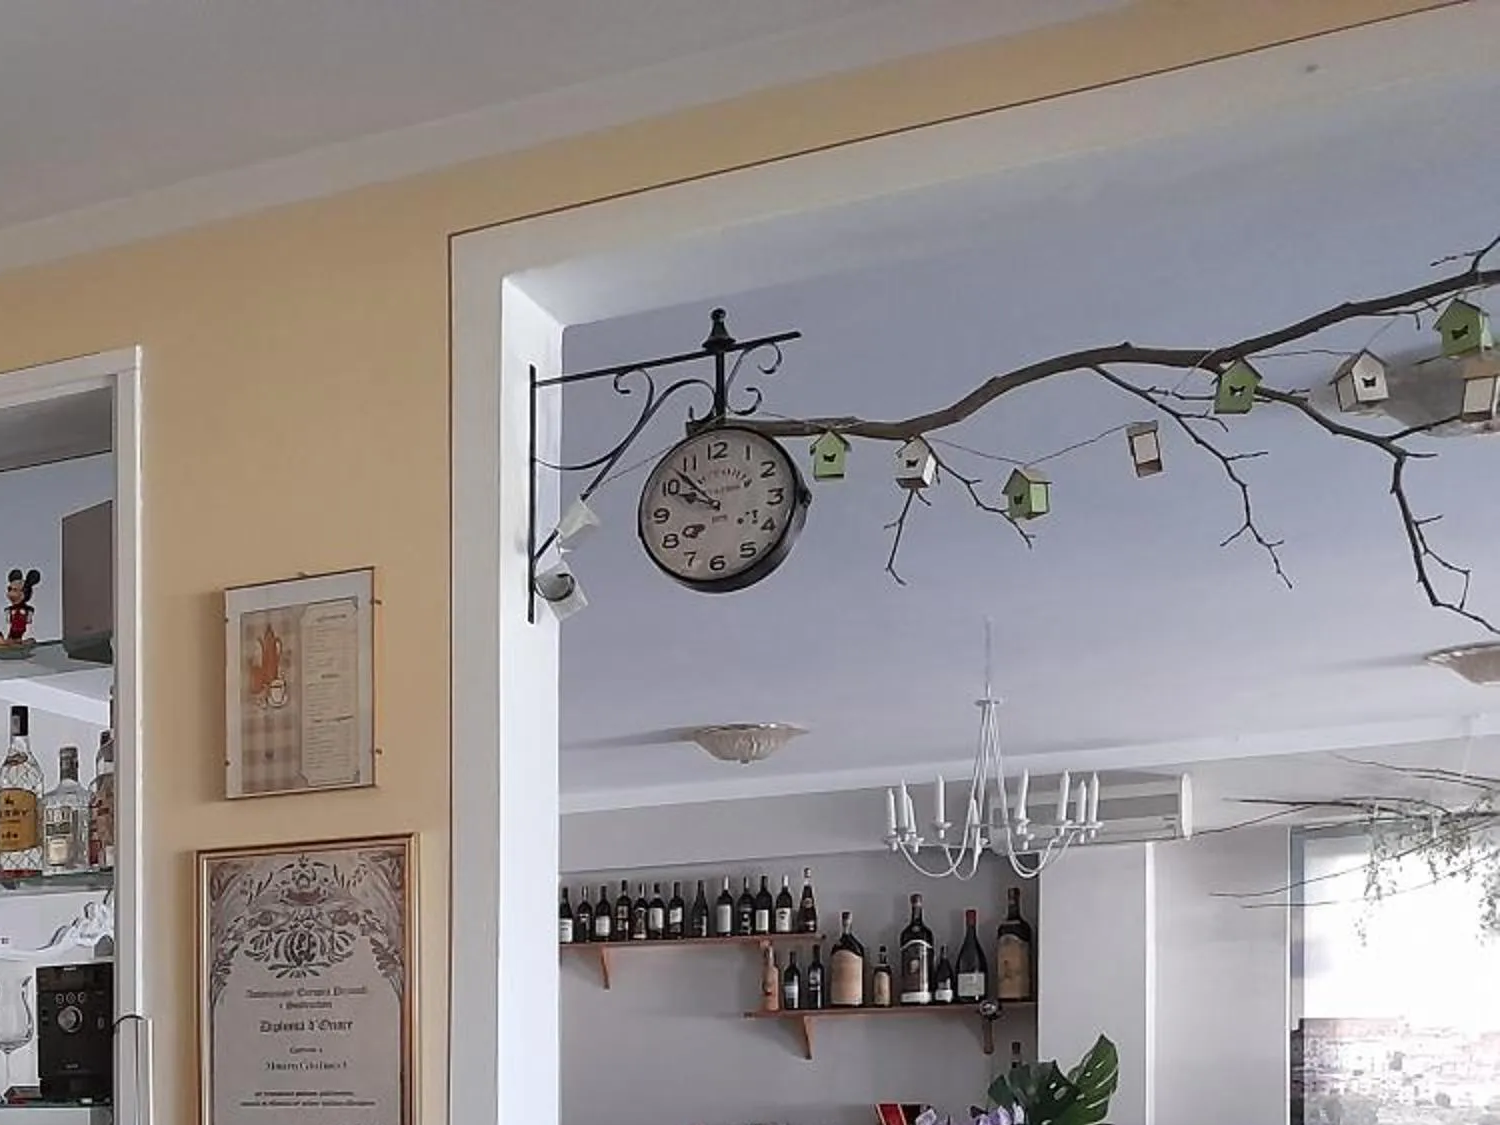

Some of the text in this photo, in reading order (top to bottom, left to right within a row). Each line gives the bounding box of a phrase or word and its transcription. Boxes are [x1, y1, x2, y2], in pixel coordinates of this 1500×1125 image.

[707, 441, 729, 461] 12
[745, 444, 751, 461] 1
[682, 455, 698, 473] 11
[760, 460, 777, 479] 2
[662, 479, 681, 497] 10
[766, 487, 785, 506] 3
[653, 507, 671, 524] 9
[760, 517, 777, 532] 4
[661, 533, 680, 549] 8
[739, 541, 757, 559] 5
[683, 551, 697, 567] 7
[709, 555, 727, 571] 6
